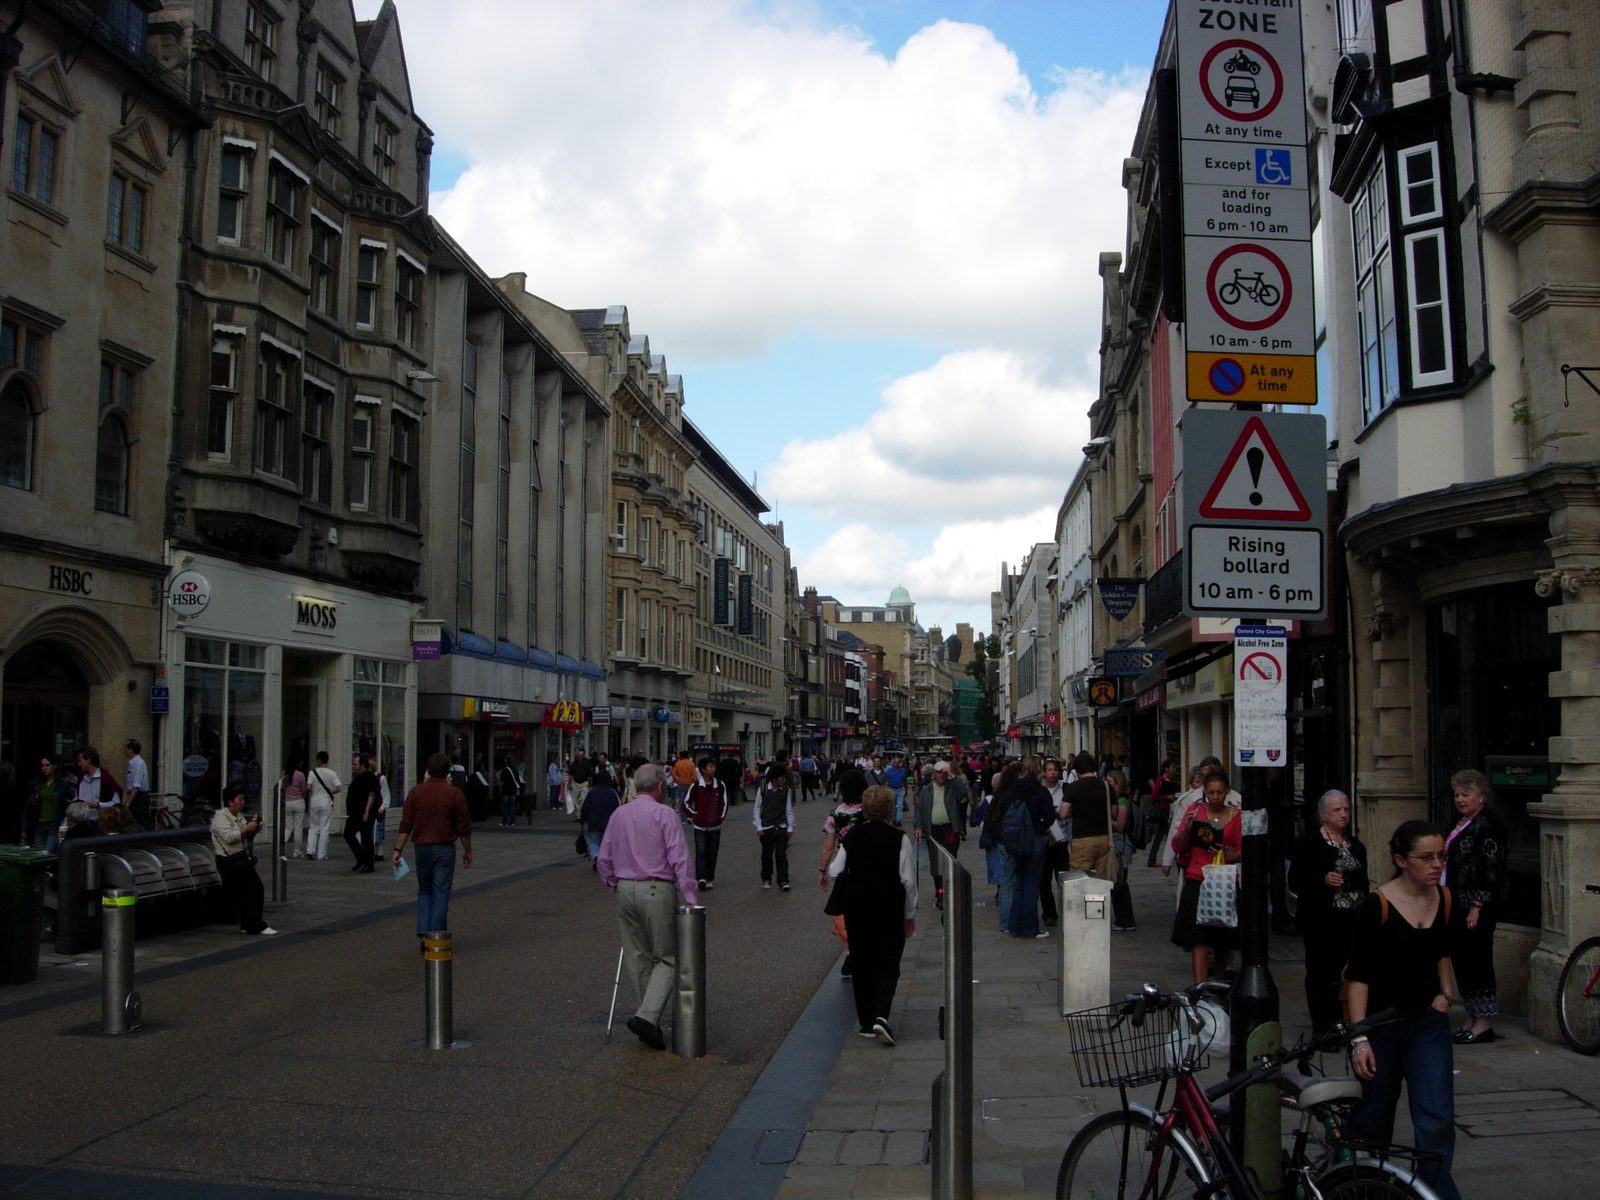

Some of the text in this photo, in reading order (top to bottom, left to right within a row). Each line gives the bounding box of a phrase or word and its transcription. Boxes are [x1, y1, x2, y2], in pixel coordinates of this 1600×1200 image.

[1199, 8, 1278, 34] ZONE
[1205, 123, 1283, 138] At any time
[1205, 157, 1252, 172] Except
[1222, 188, 1271, 200] and for
[1222, 201, 1272, 217] loading
[1206, 219, 1215, 230] 6
[1219, 222, 1239, 232] pm
[1250, 220, 1265, 232] 10
[1269, 224, 1289, 233] am
[1209, 334, 1226, 346] 10
[1229, 337, 1249, 347] am
[1260, 336, 1269, 347] 6
[1272, 339, 1292, 350] pm
[1250, 364, 1294, 379] At any
[1258, 379, 1287, 392] time
[1228, 536, 1286, 556] Rising
[1223, 556, 1290, 574] bollard
[49, 565, 92, 595] HSBC
[172, 594, 208, 606] HSBC
[1199, 582, 1221, 598] 10
[1226, 586, 1253, 599] am
[1269, 584, 1281, 600] 6
[1285, 588, 1313, 604] pm
[1106, 599, 1133, 607] Shopping
[297, 601, 337, 628] MOSS
[416, 628, 438, 636] MOSS
[1237, 639, 1284, 647] Alcohol Free Zone
